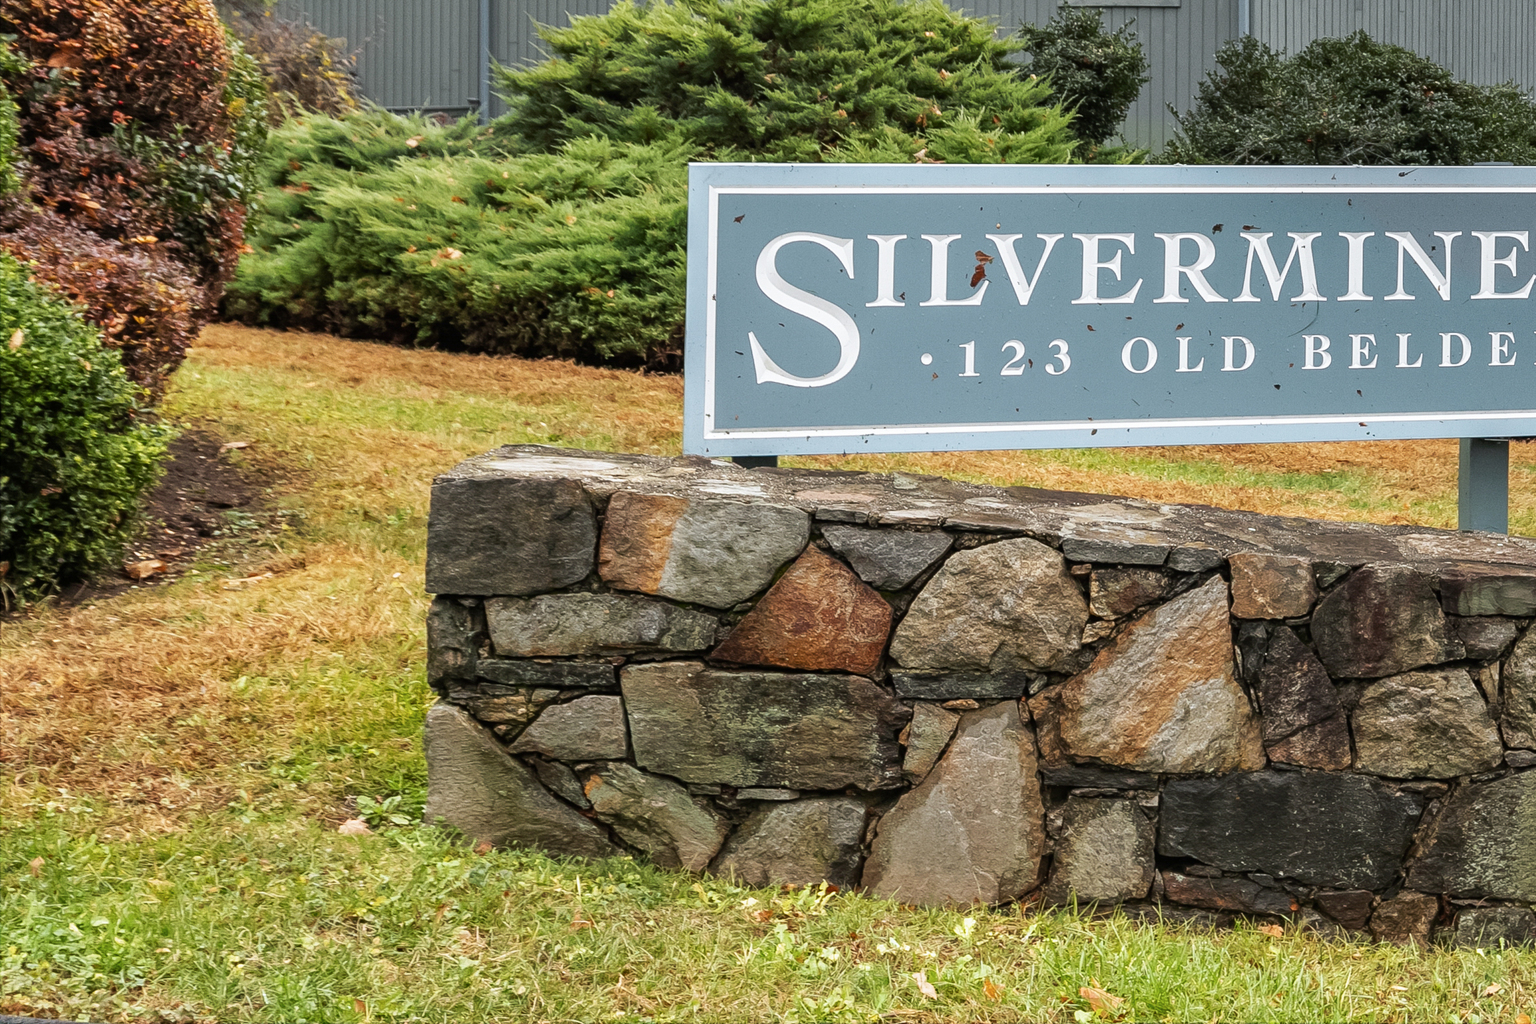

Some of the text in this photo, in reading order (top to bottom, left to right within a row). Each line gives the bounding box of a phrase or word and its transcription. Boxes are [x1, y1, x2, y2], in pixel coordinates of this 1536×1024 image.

[748, 230, 1536, 388] SILVERMINE
[958, 337, 1073, 378] 123
[1121, 335, 1256, 374] OLD
